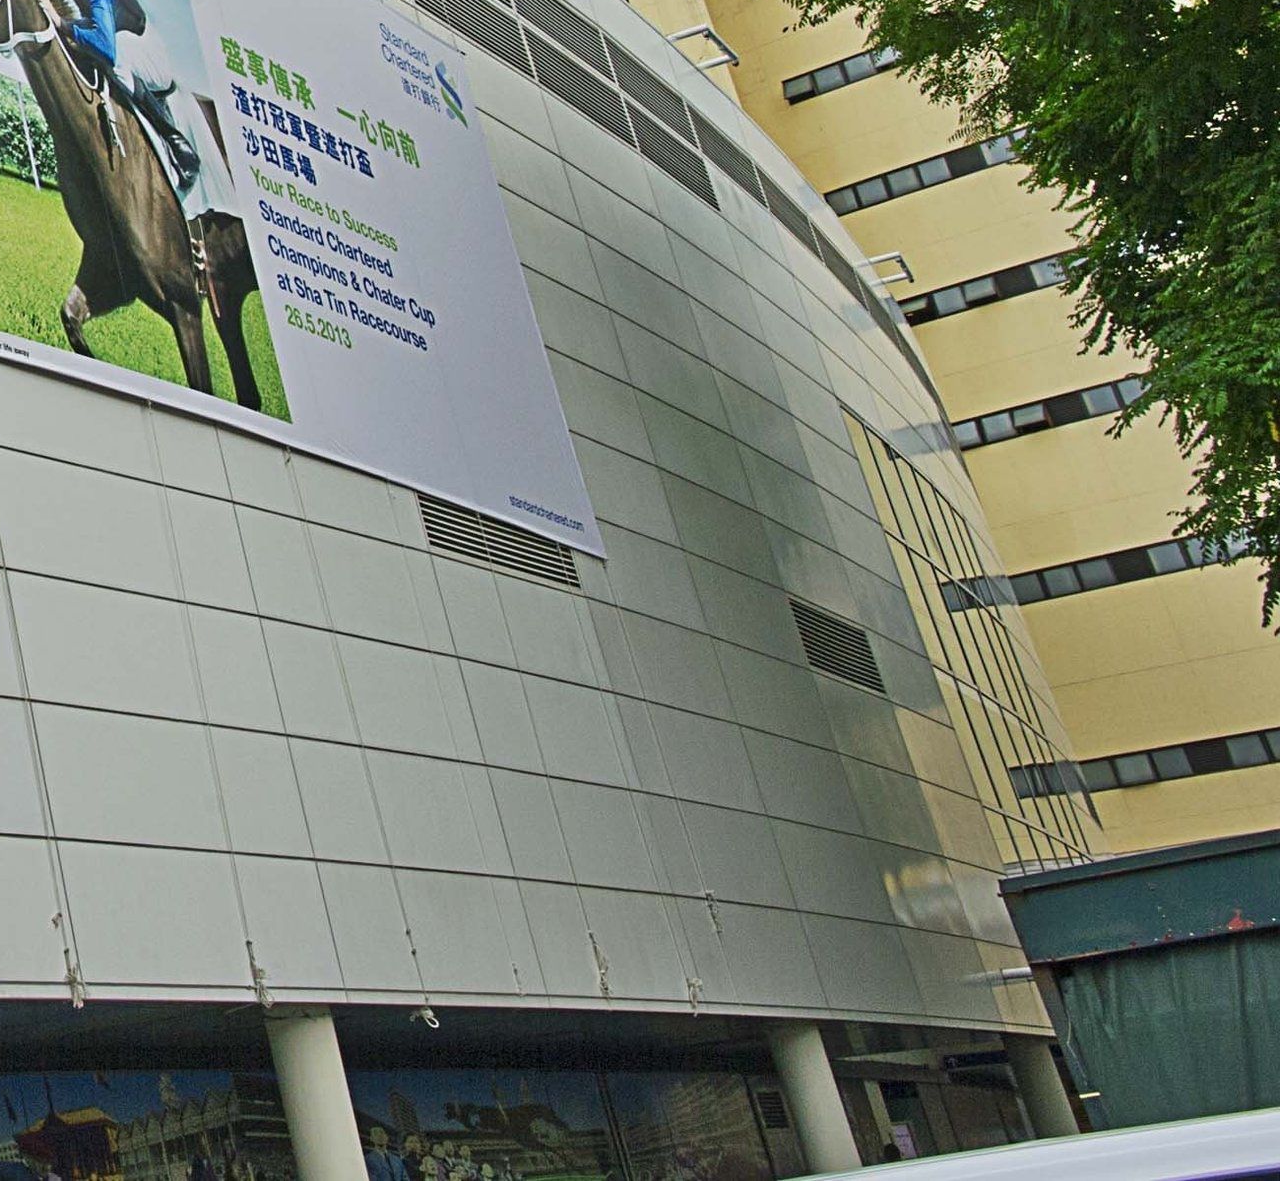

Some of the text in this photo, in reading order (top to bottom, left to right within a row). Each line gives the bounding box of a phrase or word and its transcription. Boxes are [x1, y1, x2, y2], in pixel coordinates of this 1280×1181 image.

[379, 23, 429, 67] Standard
[381, 44, 435, 89] Chartered
[220, 36, 420, 168] 盛事傳承 一心向前
[231, 83, 375, 179] 渣打冠軍暨遮打盃
[242, 126, 317, 186] 沙田馬場
[250, 165, 398, 253] Your Race to Success
[258, 199, 393, 278] Standard Chartered
[268, 234, 436, 329] Champions & Chater Cup
[277, 272, 428, 352] at Sha Tin Racecourse
[284, 304, 352, 350] 26.5.2013
